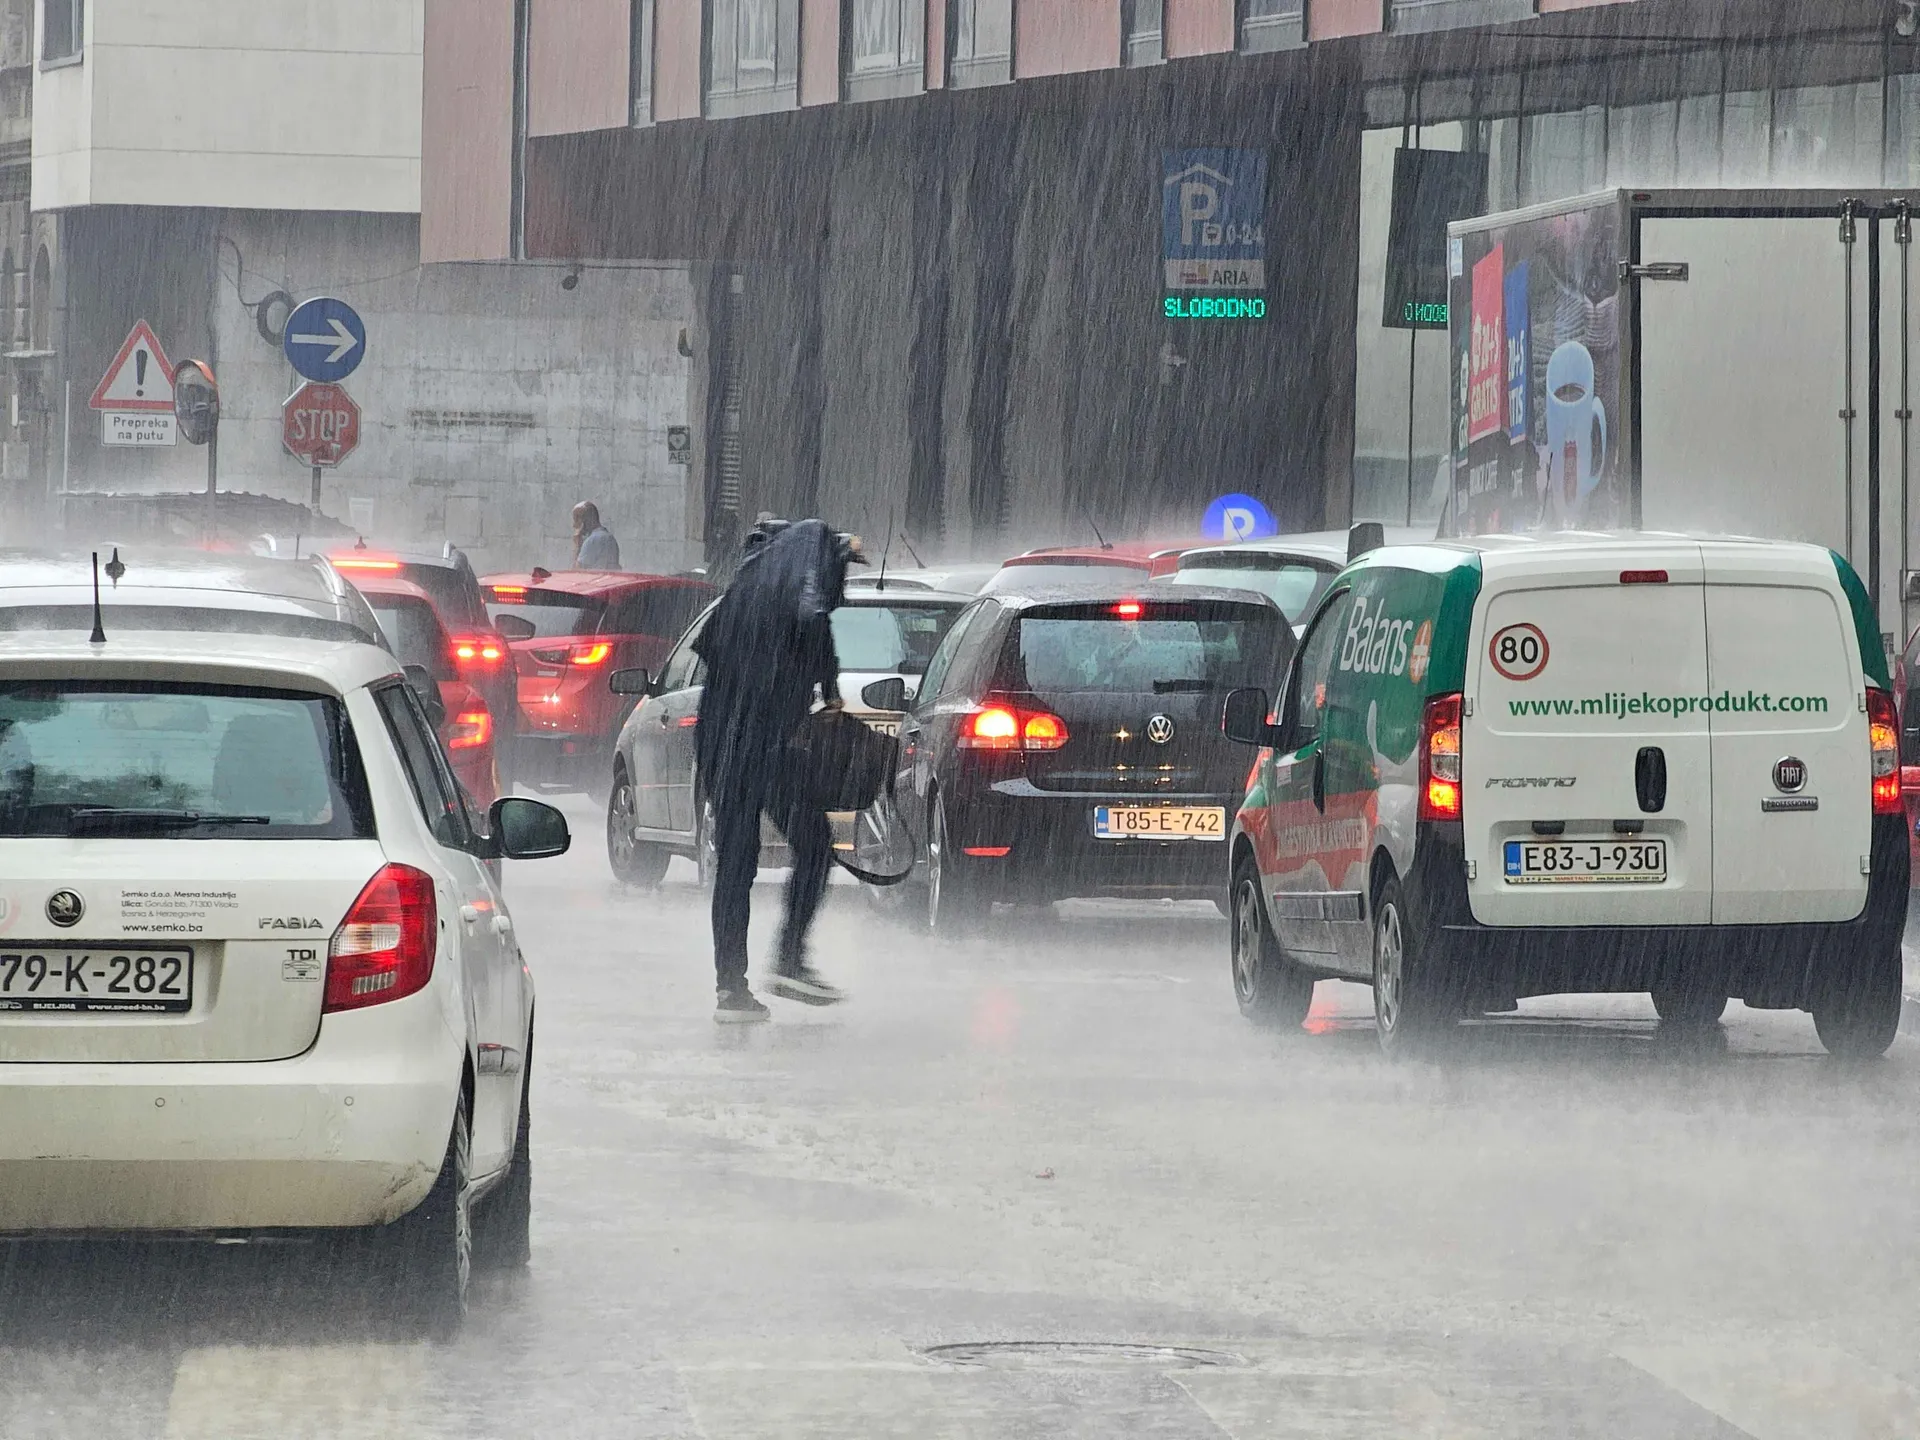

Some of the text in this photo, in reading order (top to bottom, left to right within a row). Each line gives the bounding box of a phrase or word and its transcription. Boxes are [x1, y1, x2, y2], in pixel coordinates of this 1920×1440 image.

[1180, 182, 1218, 245] P
[1212, 270, 1249, 285] ARIA
[1164, 297, 1266, 318] SLOBODNO
[113, 416, 169, 430] Prepreka
[294, 408, 350, 442] STOP
[117, 430, 164, 442] na putu
[1223, 507, 1255, 541] P
[1500, 636, 1539, 664] 80
[1509, 690, 1828, 719] www.mlijekoprodukt.com
[1780, 766, 1801, 783] FIAT
[1112, 811, 1219, 832] T85-E-742
[1525, 846, 1660, 871] E83-J-930
[121, 890, 149, 899] Semko
[173, 890, 201, 899] Mesna
[202, 891, 237, 900] Industrija
[121, 900, 144, 908] Ulica:
[121, 910, 147, 918] Bosnia
[156, 910, 206, 919] Herzegovina
[122, 923, 204, 932] www.semko.ba
[258, 917, 324, 930] FABIA
[286, 949, 317, 960] TDI
[0, 954, 183, 994] 79-K-282
